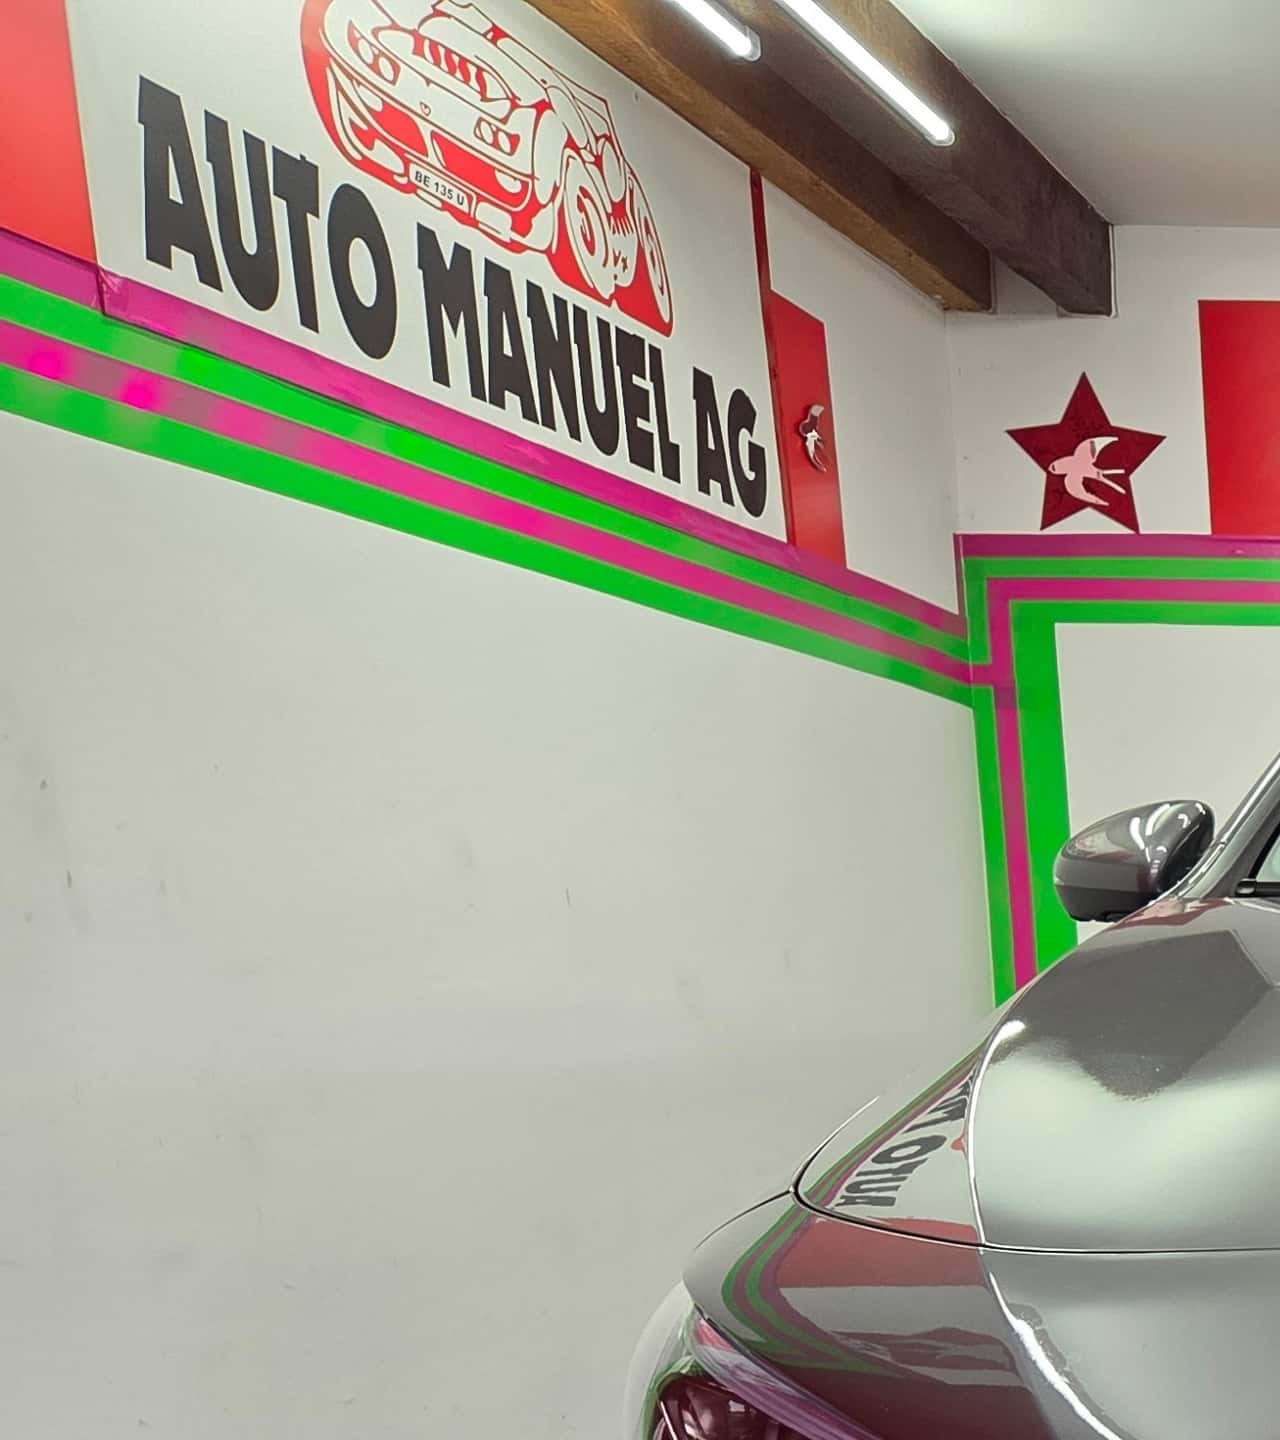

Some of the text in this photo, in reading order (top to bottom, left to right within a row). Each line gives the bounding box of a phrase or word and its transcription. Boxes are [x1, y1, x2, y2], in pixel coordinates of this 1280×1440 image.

[138, 75, 767, 518] AUTO MANUEL AG
